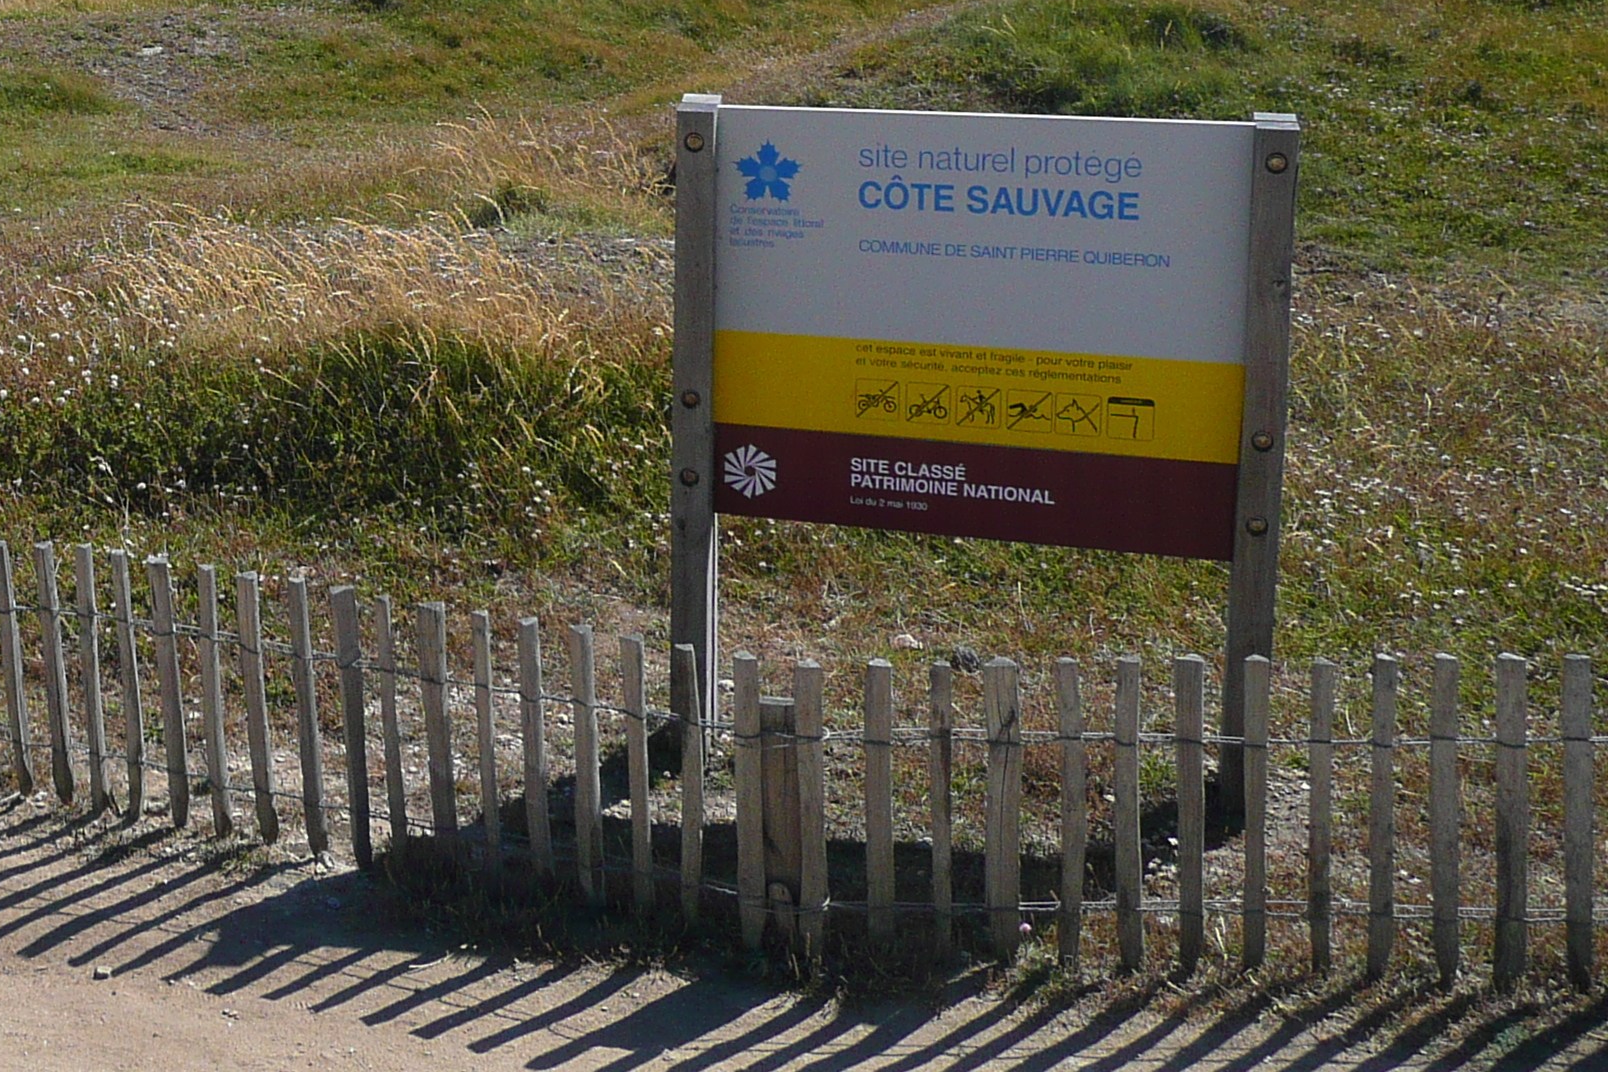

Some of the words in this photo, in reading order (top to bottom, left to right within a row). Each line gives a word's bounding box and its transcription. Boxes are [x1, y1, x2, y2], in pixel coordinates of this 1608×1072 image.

[859, 142, 908, 169] site
[918, 146, 1015, 173] naturel
[1025, 150, 1143, 184] protégé
[858, 174, 955, 212] CÔTE
[966, 184, 1140, 221] SAUVAGE
[859, 239, 941, 256] COMMUNE
[945, 244, 967, 258] DE
[970, 245, 1017, 260] SAINT
[1020, 247, 1080, 263] PIERRE
[1083, 250, 1171, 268] QUIBERON
[855, 344, 873, 353] cet
[876, 345, 916, 357] espace
[919, 348, 937, 357] est
[940, 348, 974, 360] vivant
[976, 351, 987, 361] et
[990, 352, 1025, 365] fragile
[1036, 356, 1063, 366] pour
[1065, 357, 1095, 368] votre
[1098, 359, 1133, 371] plaisir
[856, 357, 867, 366] et
[869, 358, 897, 368] votre
[951, 363, 1002, 377] acceptez
[1005, 367, 1025, 377] ces
[850, 457, 890, 474] SITE
[894, 461, 966, 481] CLASSÉ
[850, 496, 863, 505] Loi
[865, 496, 877, 506] du
[887, 499, 904, 509] mai
[851, 474, 958, 496] PATRIMOINE
[963, 483, 1056, 505] NATIONAL
